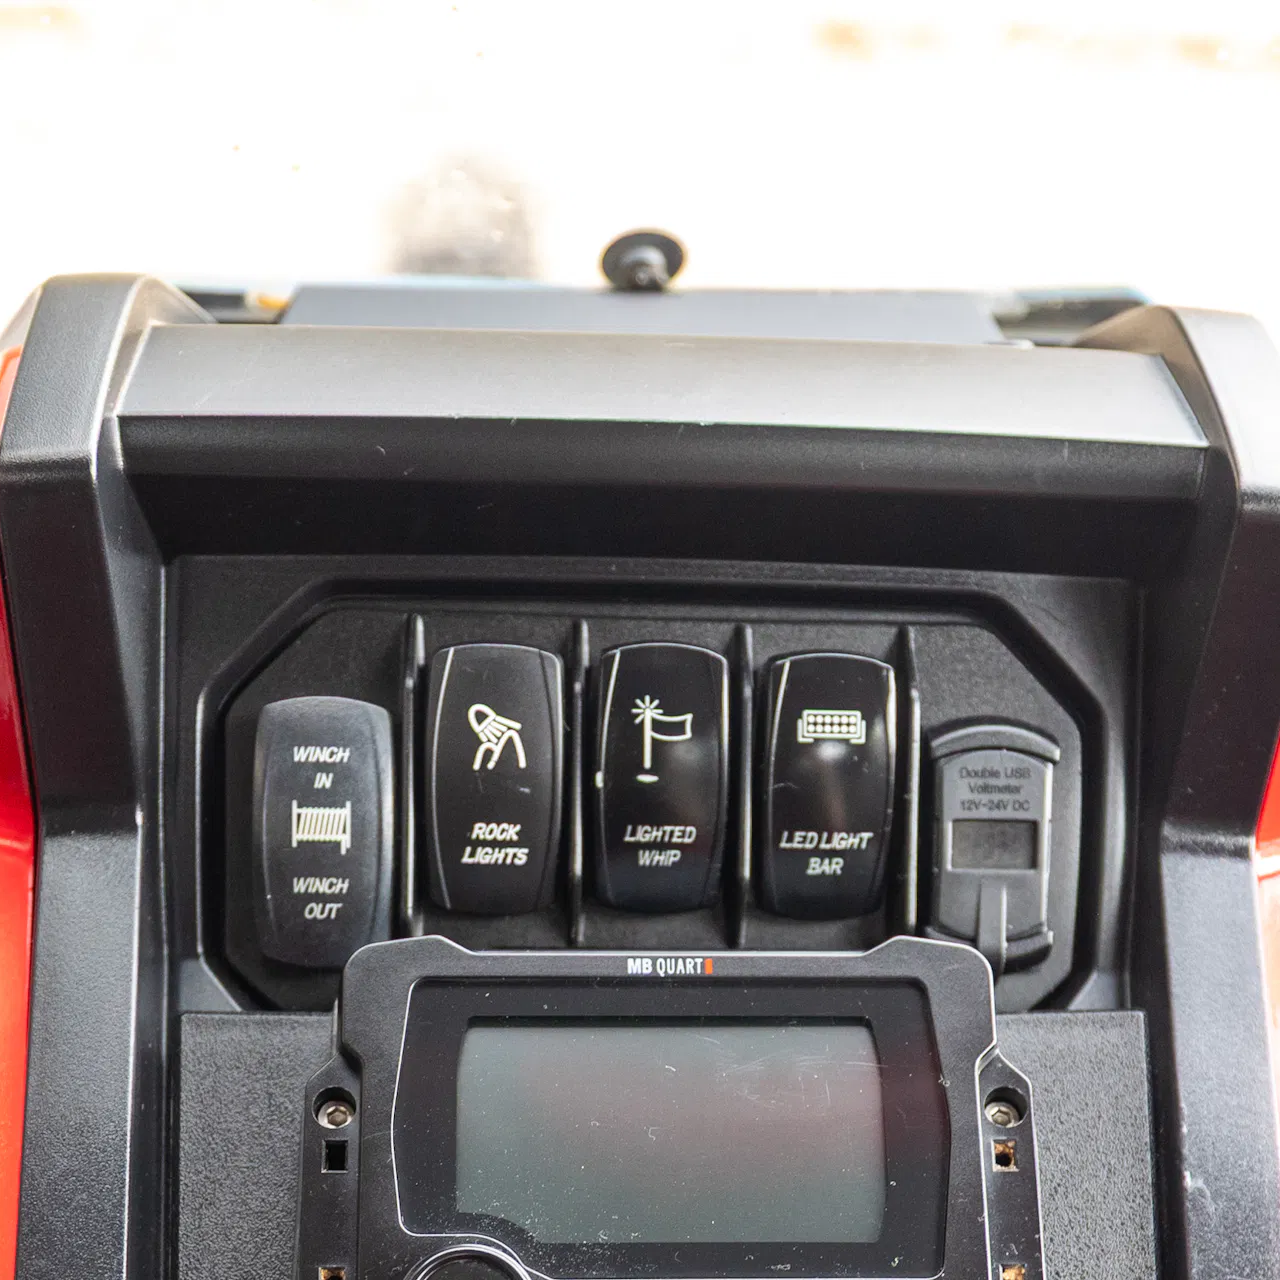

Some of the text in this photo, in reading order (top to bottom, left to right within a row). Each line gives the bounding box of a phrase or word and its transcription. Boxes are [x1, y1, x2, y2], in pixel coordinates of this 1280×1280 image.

[293, 746, 350, 763] WINCH
[314, 772, 333, 789] IN
[959, 766, 1032, 780] Double USB
[967, 782, 1024, 795] Voltmeter
[1012, 799, 1031, 812] DC
[471, 822, 521, 841] ROCK
[624, 825, 697, 844] LIGHTED
[779, 831, 874, 850] LED LIGHT
[461, 847, 529, 865] LIGHTS
[637, 850, 681, 867] WHIP
[806, 857, 844, 876] BAR
[293, 877, 350, 894] WINCH
[304, 903, 343, 920] OUT
[627, 957, 704, 977] MB QUART
